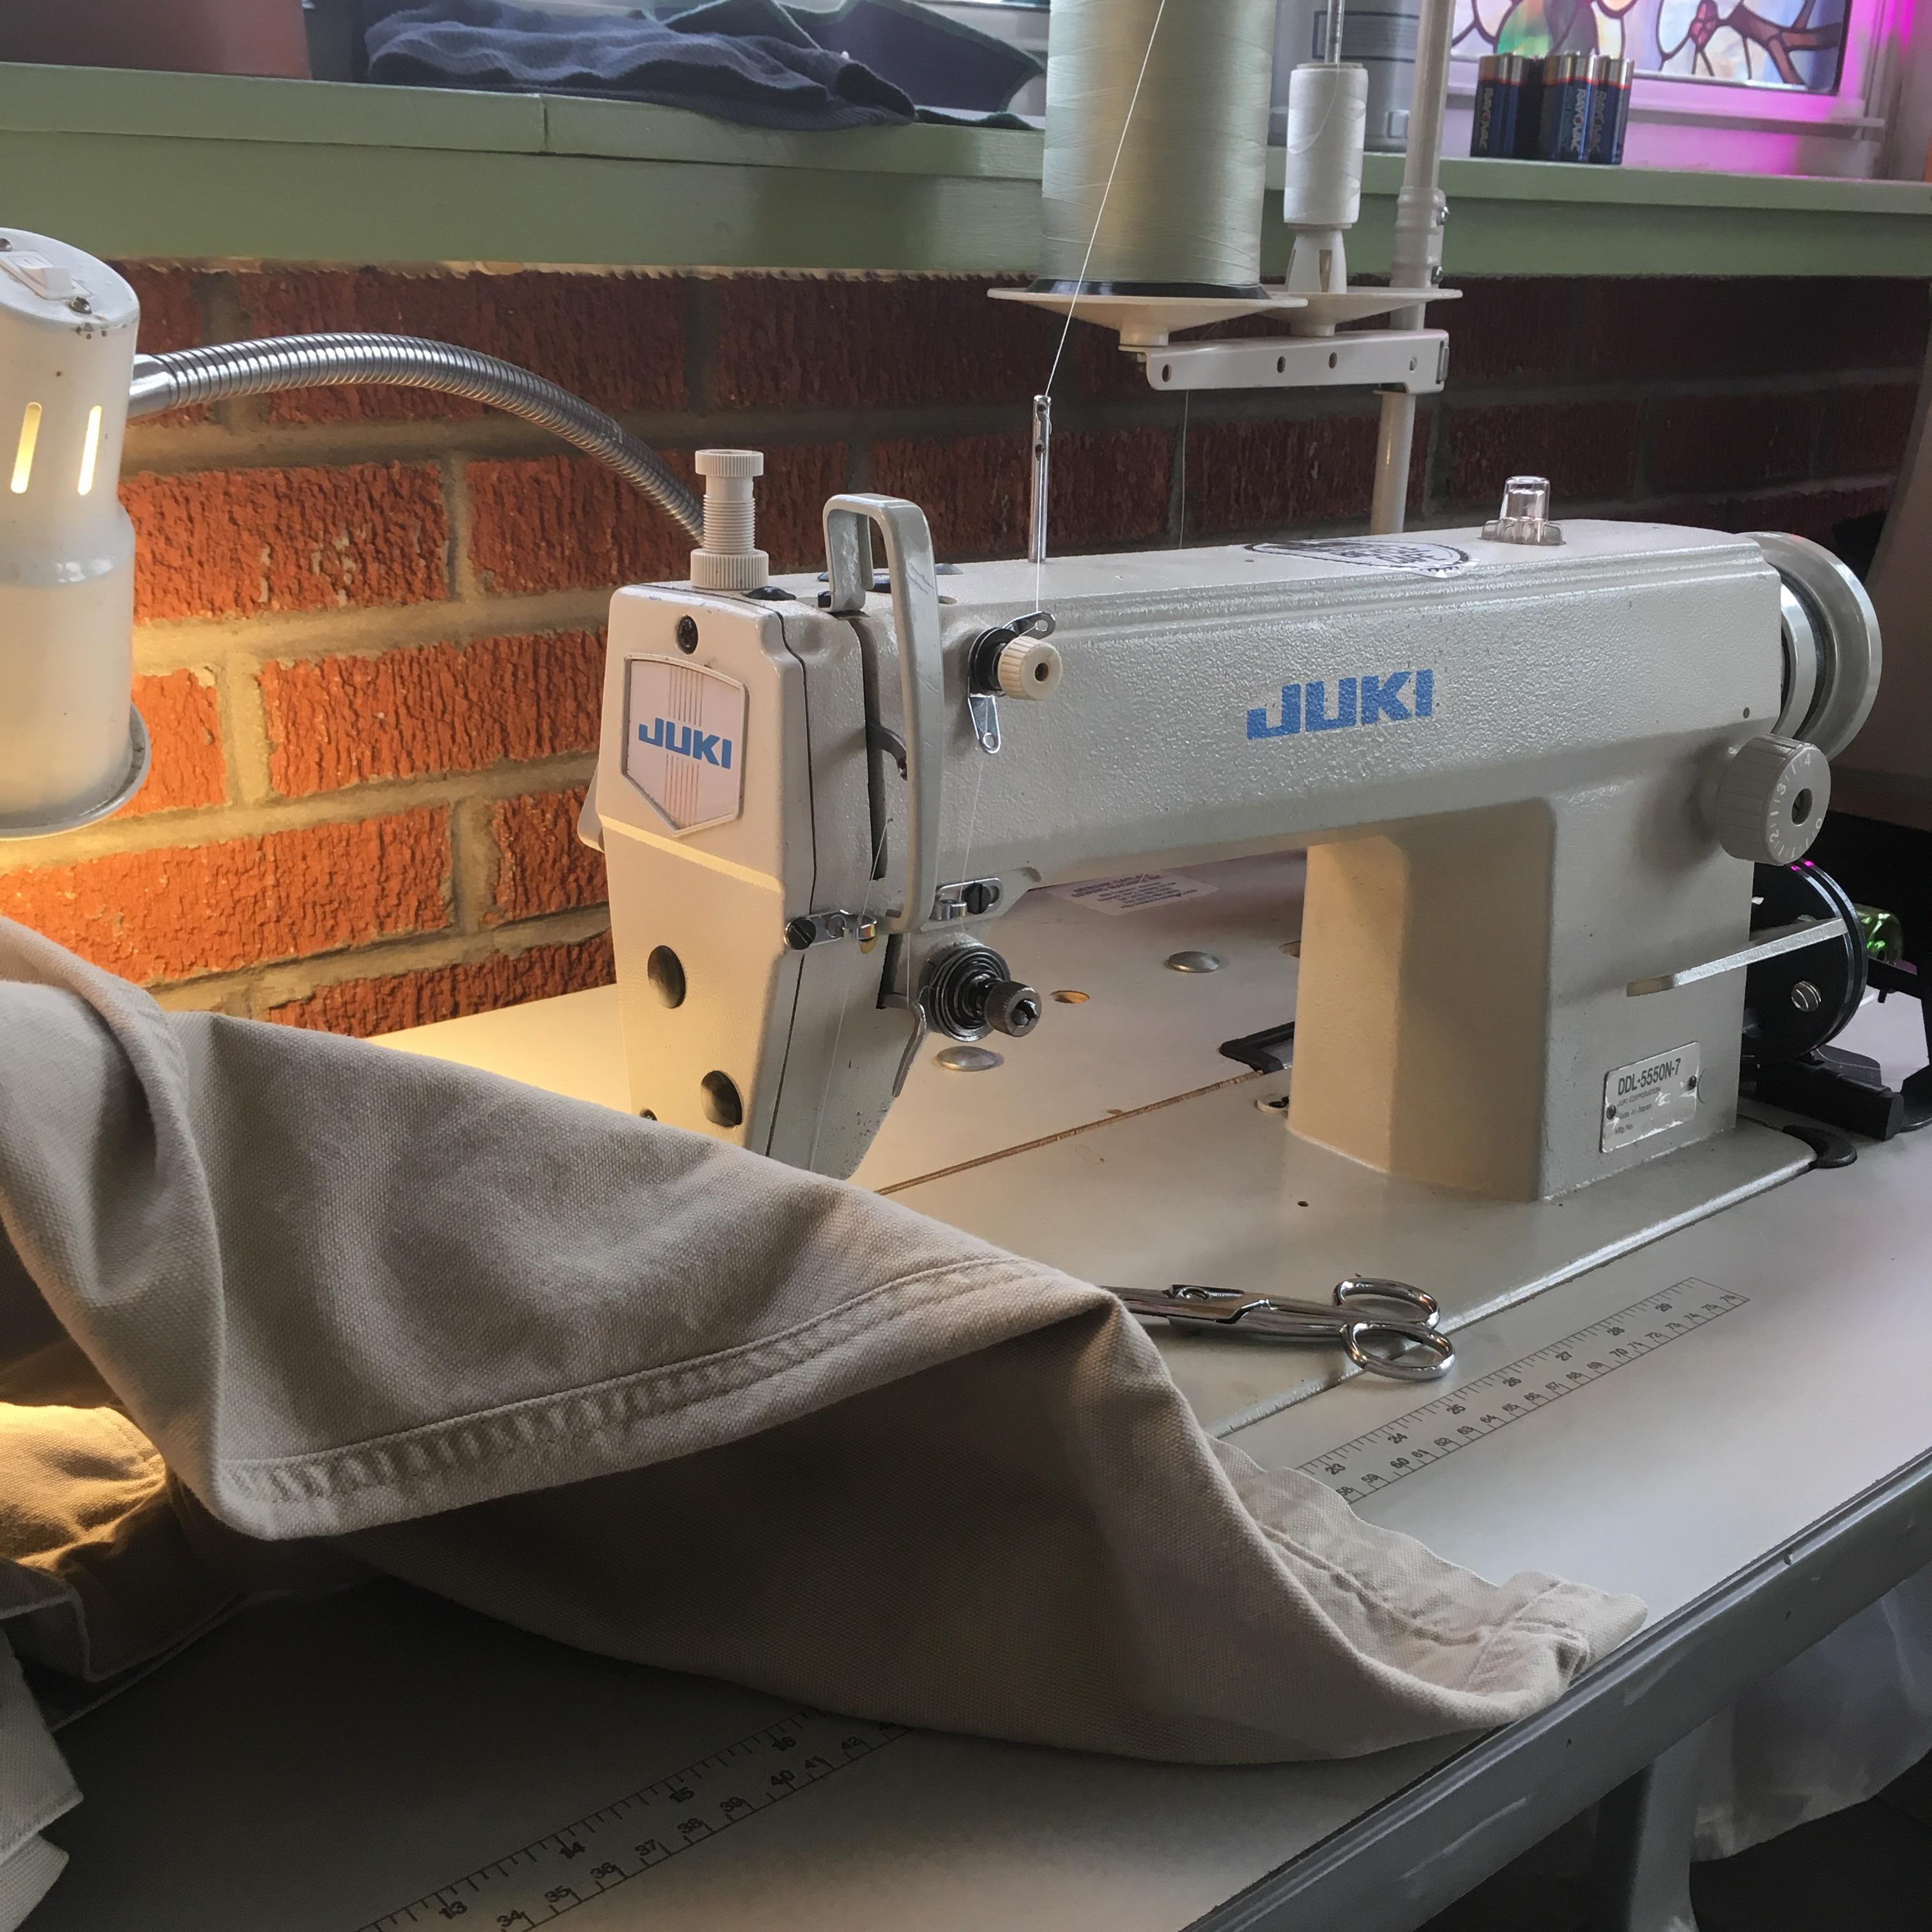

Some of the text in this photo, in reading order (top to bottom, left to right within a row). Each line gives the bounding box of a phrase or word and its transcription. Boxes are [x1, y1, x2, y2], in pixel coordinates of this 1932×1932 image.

[1479, 87, 1494, 149] RAYOVAC
[1571, 88, 1586, 151] RAYOVAC
[1590, 90, 1607, 152] RAYOVAC
[1246, 669, 1433, 740] JUKI
[639, 717, 732, 769] JUKI
[1804, 753, 1811, 767] 4
[1777, 783, 1786, 795] 3
[1769, 829, 1779, 843] 2
[1815, 818, 1821, 830] 0
[1618, 1058, 1682, 1096] DDL-5550N-7
[1629, 1087, 1660, 1103] CORPORATION
[1637, 1103, 1652, 1114] Japan
[1325, 1463, 1346, 1475] 23
[1388, 1432, 1407, 1444] 24
[1446, 1404, 1466, 1414] 25
[1502, 1377, 1522, 1387] 26
[1556, 1351, 1572, 1361] 27
[1336, 1486, 1353, 1496] 58
[1361, 1473, 1378, 1483] 59
[1390, 1457, 1410, 1468] 60
[1411, 1449, 1429, 1458] 61
[1434, 1438, 1451, 1446] 62
[1457, 1426, 1473, 1434] 63
[1480, 1414, 1496, 1423] 64
[1545, 1381, 1560, 1390] 67
[1609, 1348, 1628, 1357] 70
[1644, 1332, 1661, 1340] 72
[439, 1736, 797, 1919] 13 14 15 16
[496, 1736, 863, 1927] 34 35 36 37 38 39 40 41 42
